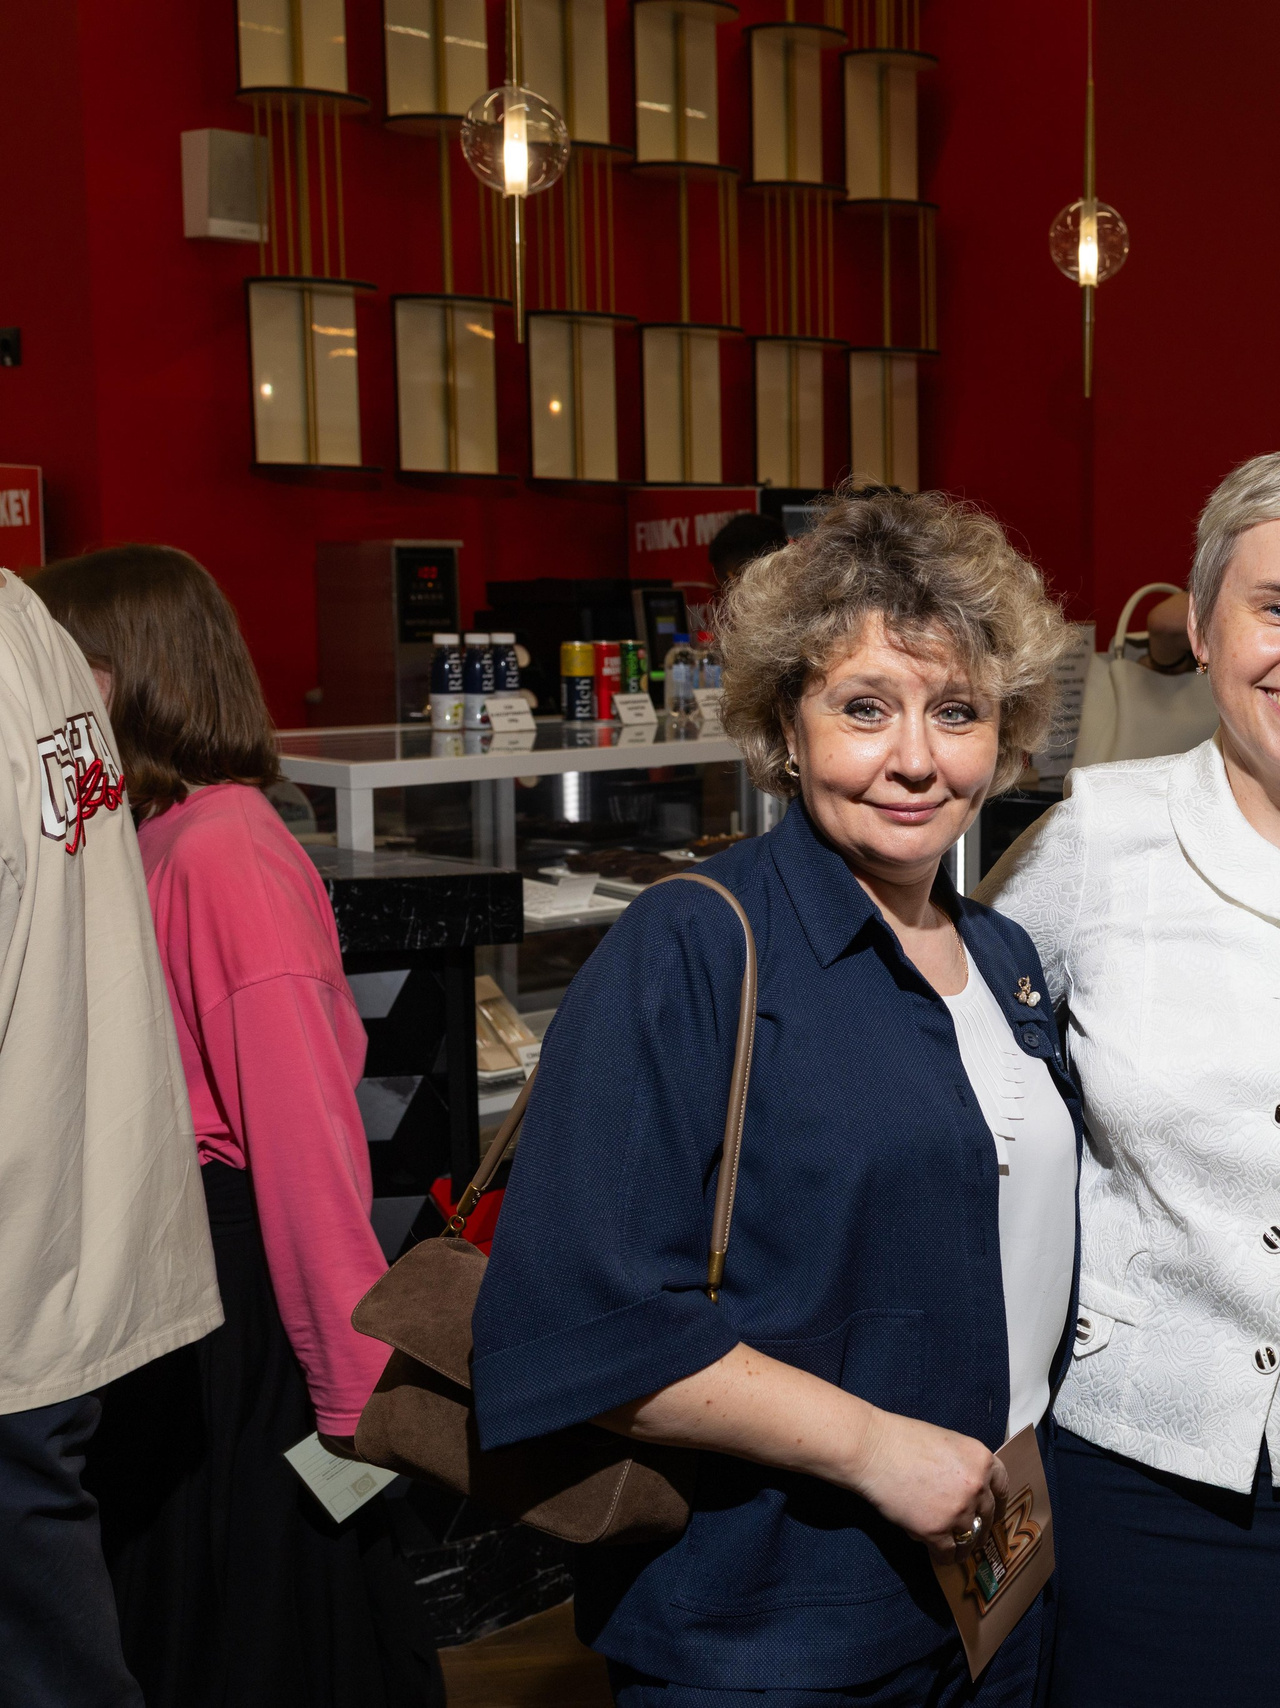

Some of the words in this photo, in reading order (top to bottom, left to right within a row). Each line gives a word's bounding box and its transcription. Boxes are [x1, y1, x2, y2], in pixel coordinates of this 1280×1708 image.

[634, 516, 690, 553] FUNKY
[446, 652, 463, 691] Rich
[480, 653, 494, 691] Rich
[575, 679, 591, 717] Rich
[984, 1537, 1006, 1581] СБОРНАЯ
